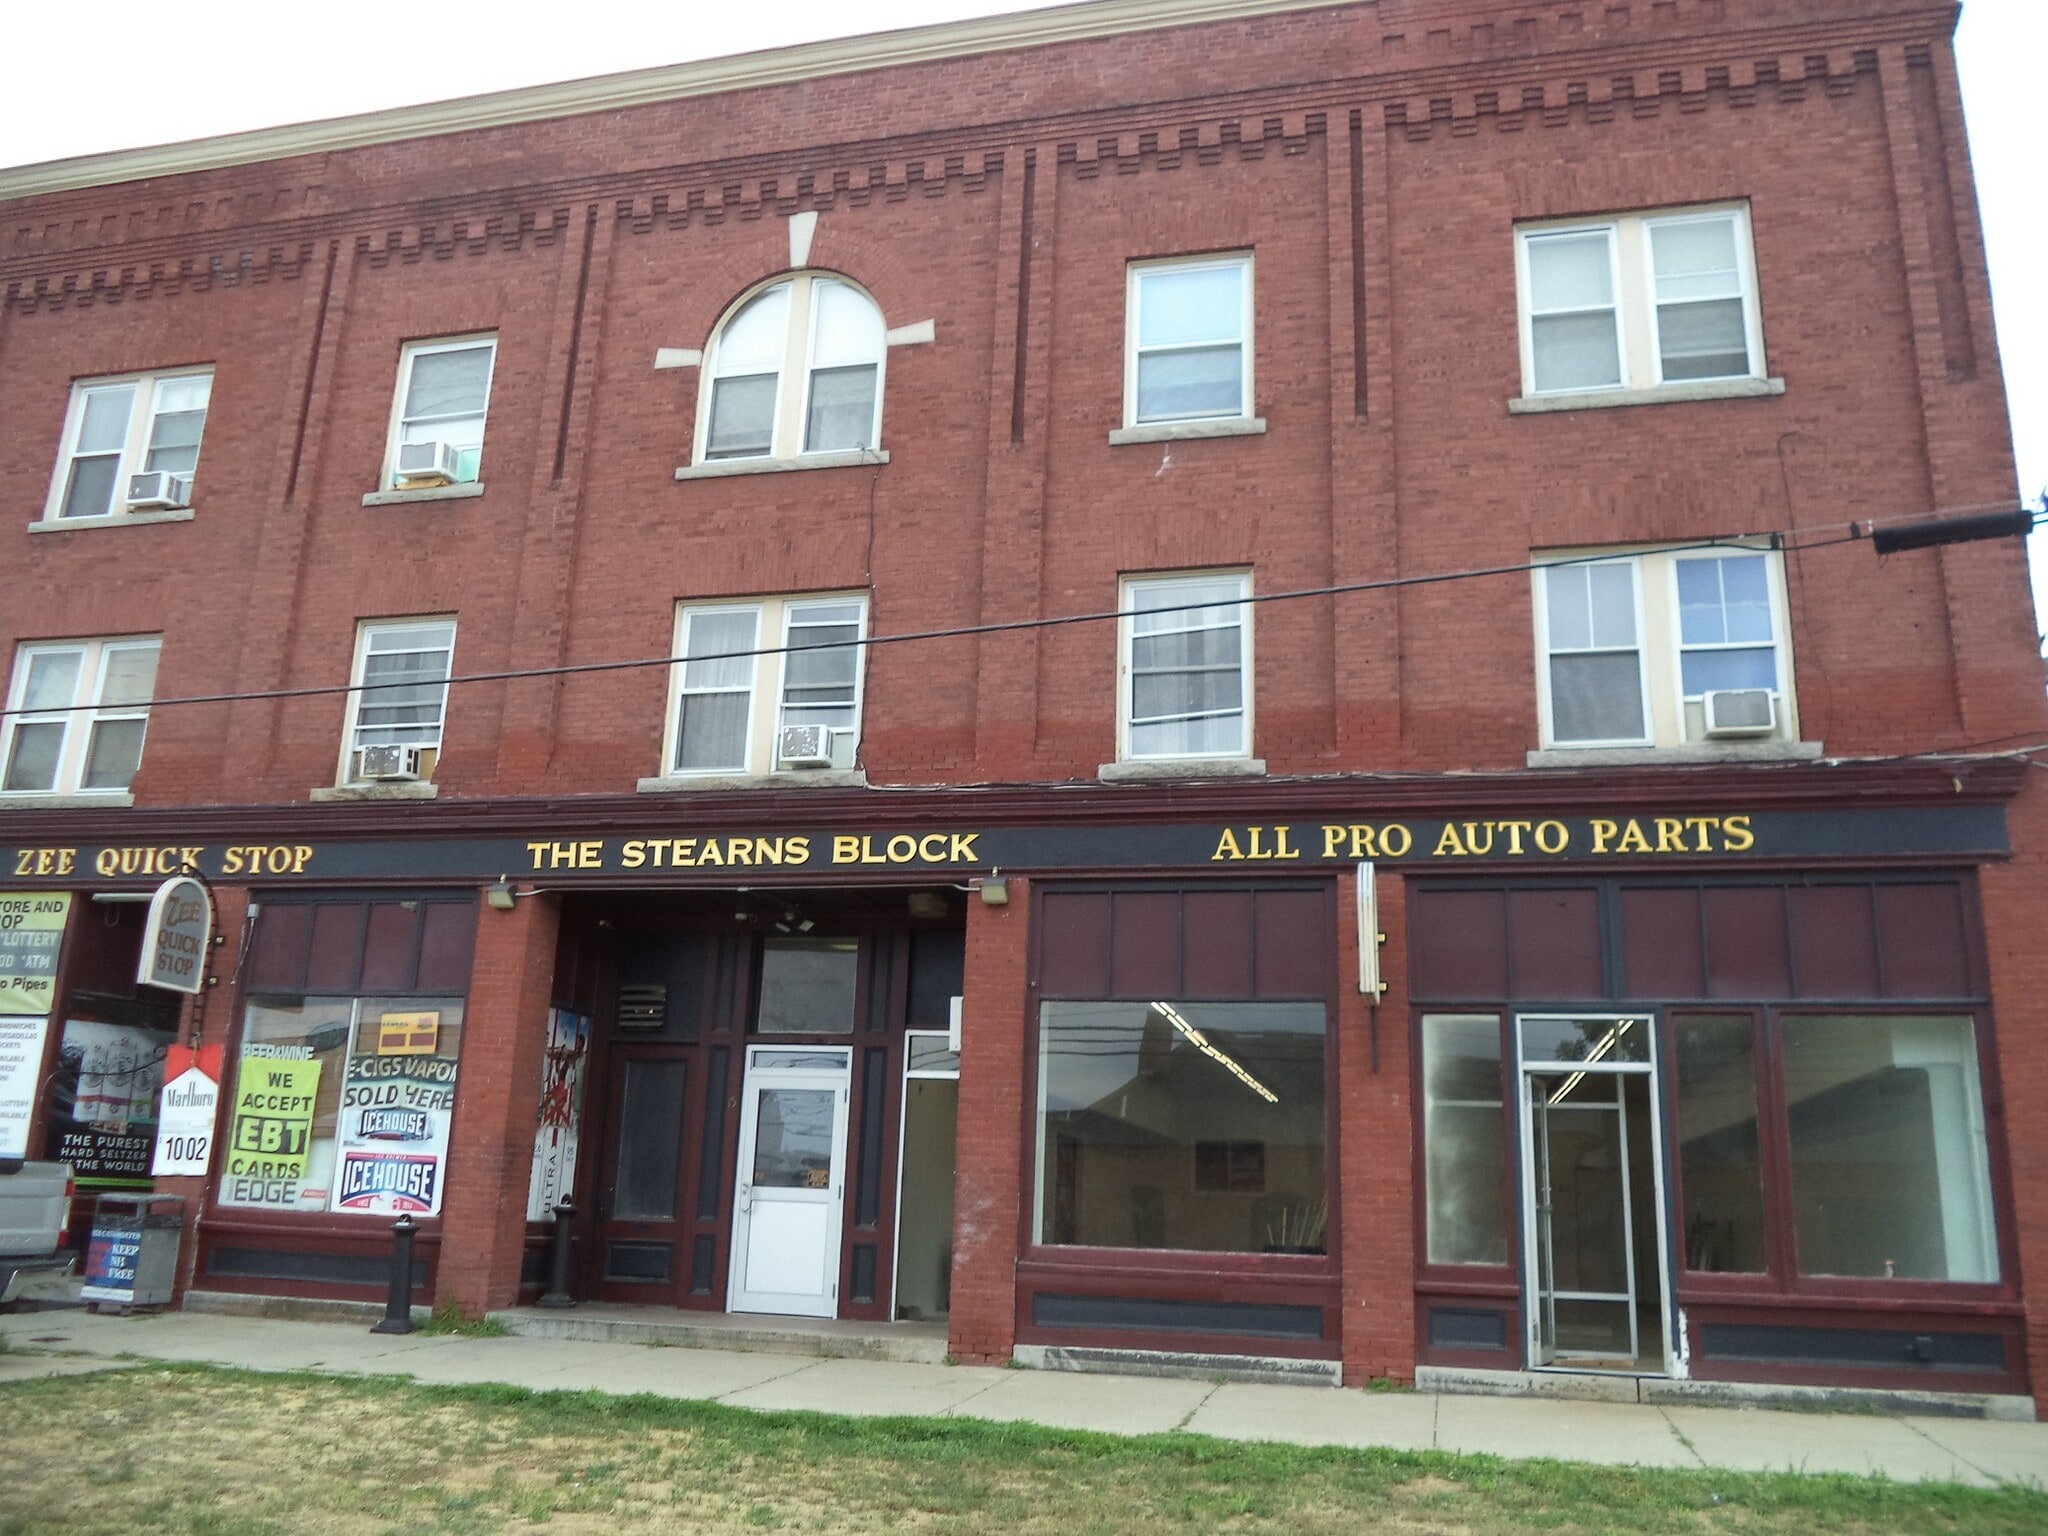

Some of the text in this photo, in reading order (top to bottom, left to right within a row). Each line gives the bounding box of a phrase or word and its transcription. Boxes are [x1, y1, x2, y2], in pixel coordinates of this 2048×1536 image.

[1211, 816, 1755, 861] ALL PRO AUTO PARTS
[14, 845, 314, 877] ZEE QUICK STOP
[526, 832, 980, 870] THE STEARNS BLOCK
[34, 901, 64, 913] AND
[0, 914, 24, 929] OP
[158, 930, 200, 955] QUICK
[157, 953, 194, 976] STOP
[11, 977, 49, 992] Pipes
[267, 1072, 293, 1088] WE
[168, 1082, 214, 1107] Marlboro
[242, 1093, 313, 1112] ACCEPT
[344, 1085, 399, 1107] SOLD
[361, 1110, 426, 1137] ICEHOUSE
[63, 1134, 92, 1147] THE
[97, 1136, 149, 1149] PUREST
[238, 1117, 308, 1154] EBT
[60, 1147, 147, 1160] HARD SELTZER
[75, 1160, 99, 1170] THE
[104, 1161, 146, 1172] WORLD
[231, 1158, 301, 1179] CARDS
[233, 1178, 297, 1204] EDGE
[342, 1160, 434, 1201] ICEHOUSE
[543, 1154, 557, 1214] ULTRA
